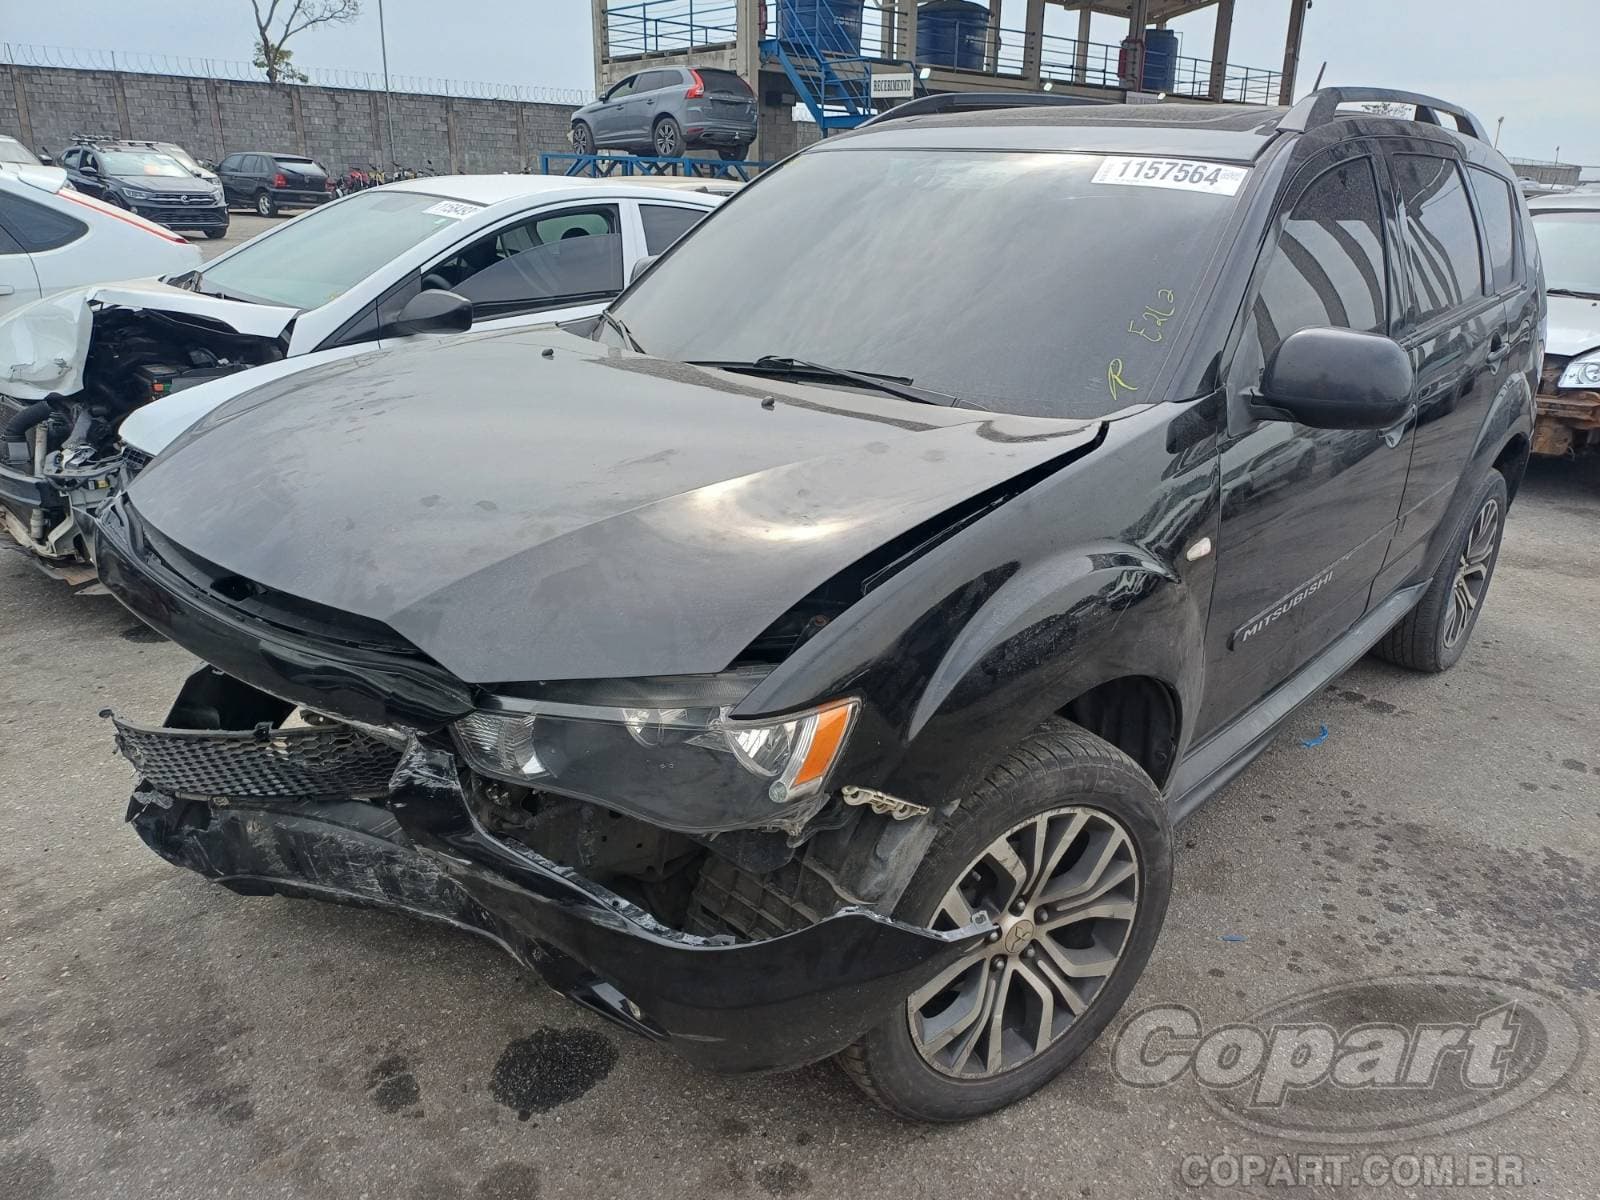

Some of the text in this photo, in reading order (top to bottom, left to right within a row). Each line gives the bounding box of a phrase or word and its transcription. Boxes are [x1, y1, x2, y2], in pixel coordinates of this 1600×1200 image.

[873, 79, 912, 92] RECEBIMENTO
[1118, 159, 1222, 186] 1157564
[1242, 570, 1333, 642] MITSUBISHI
